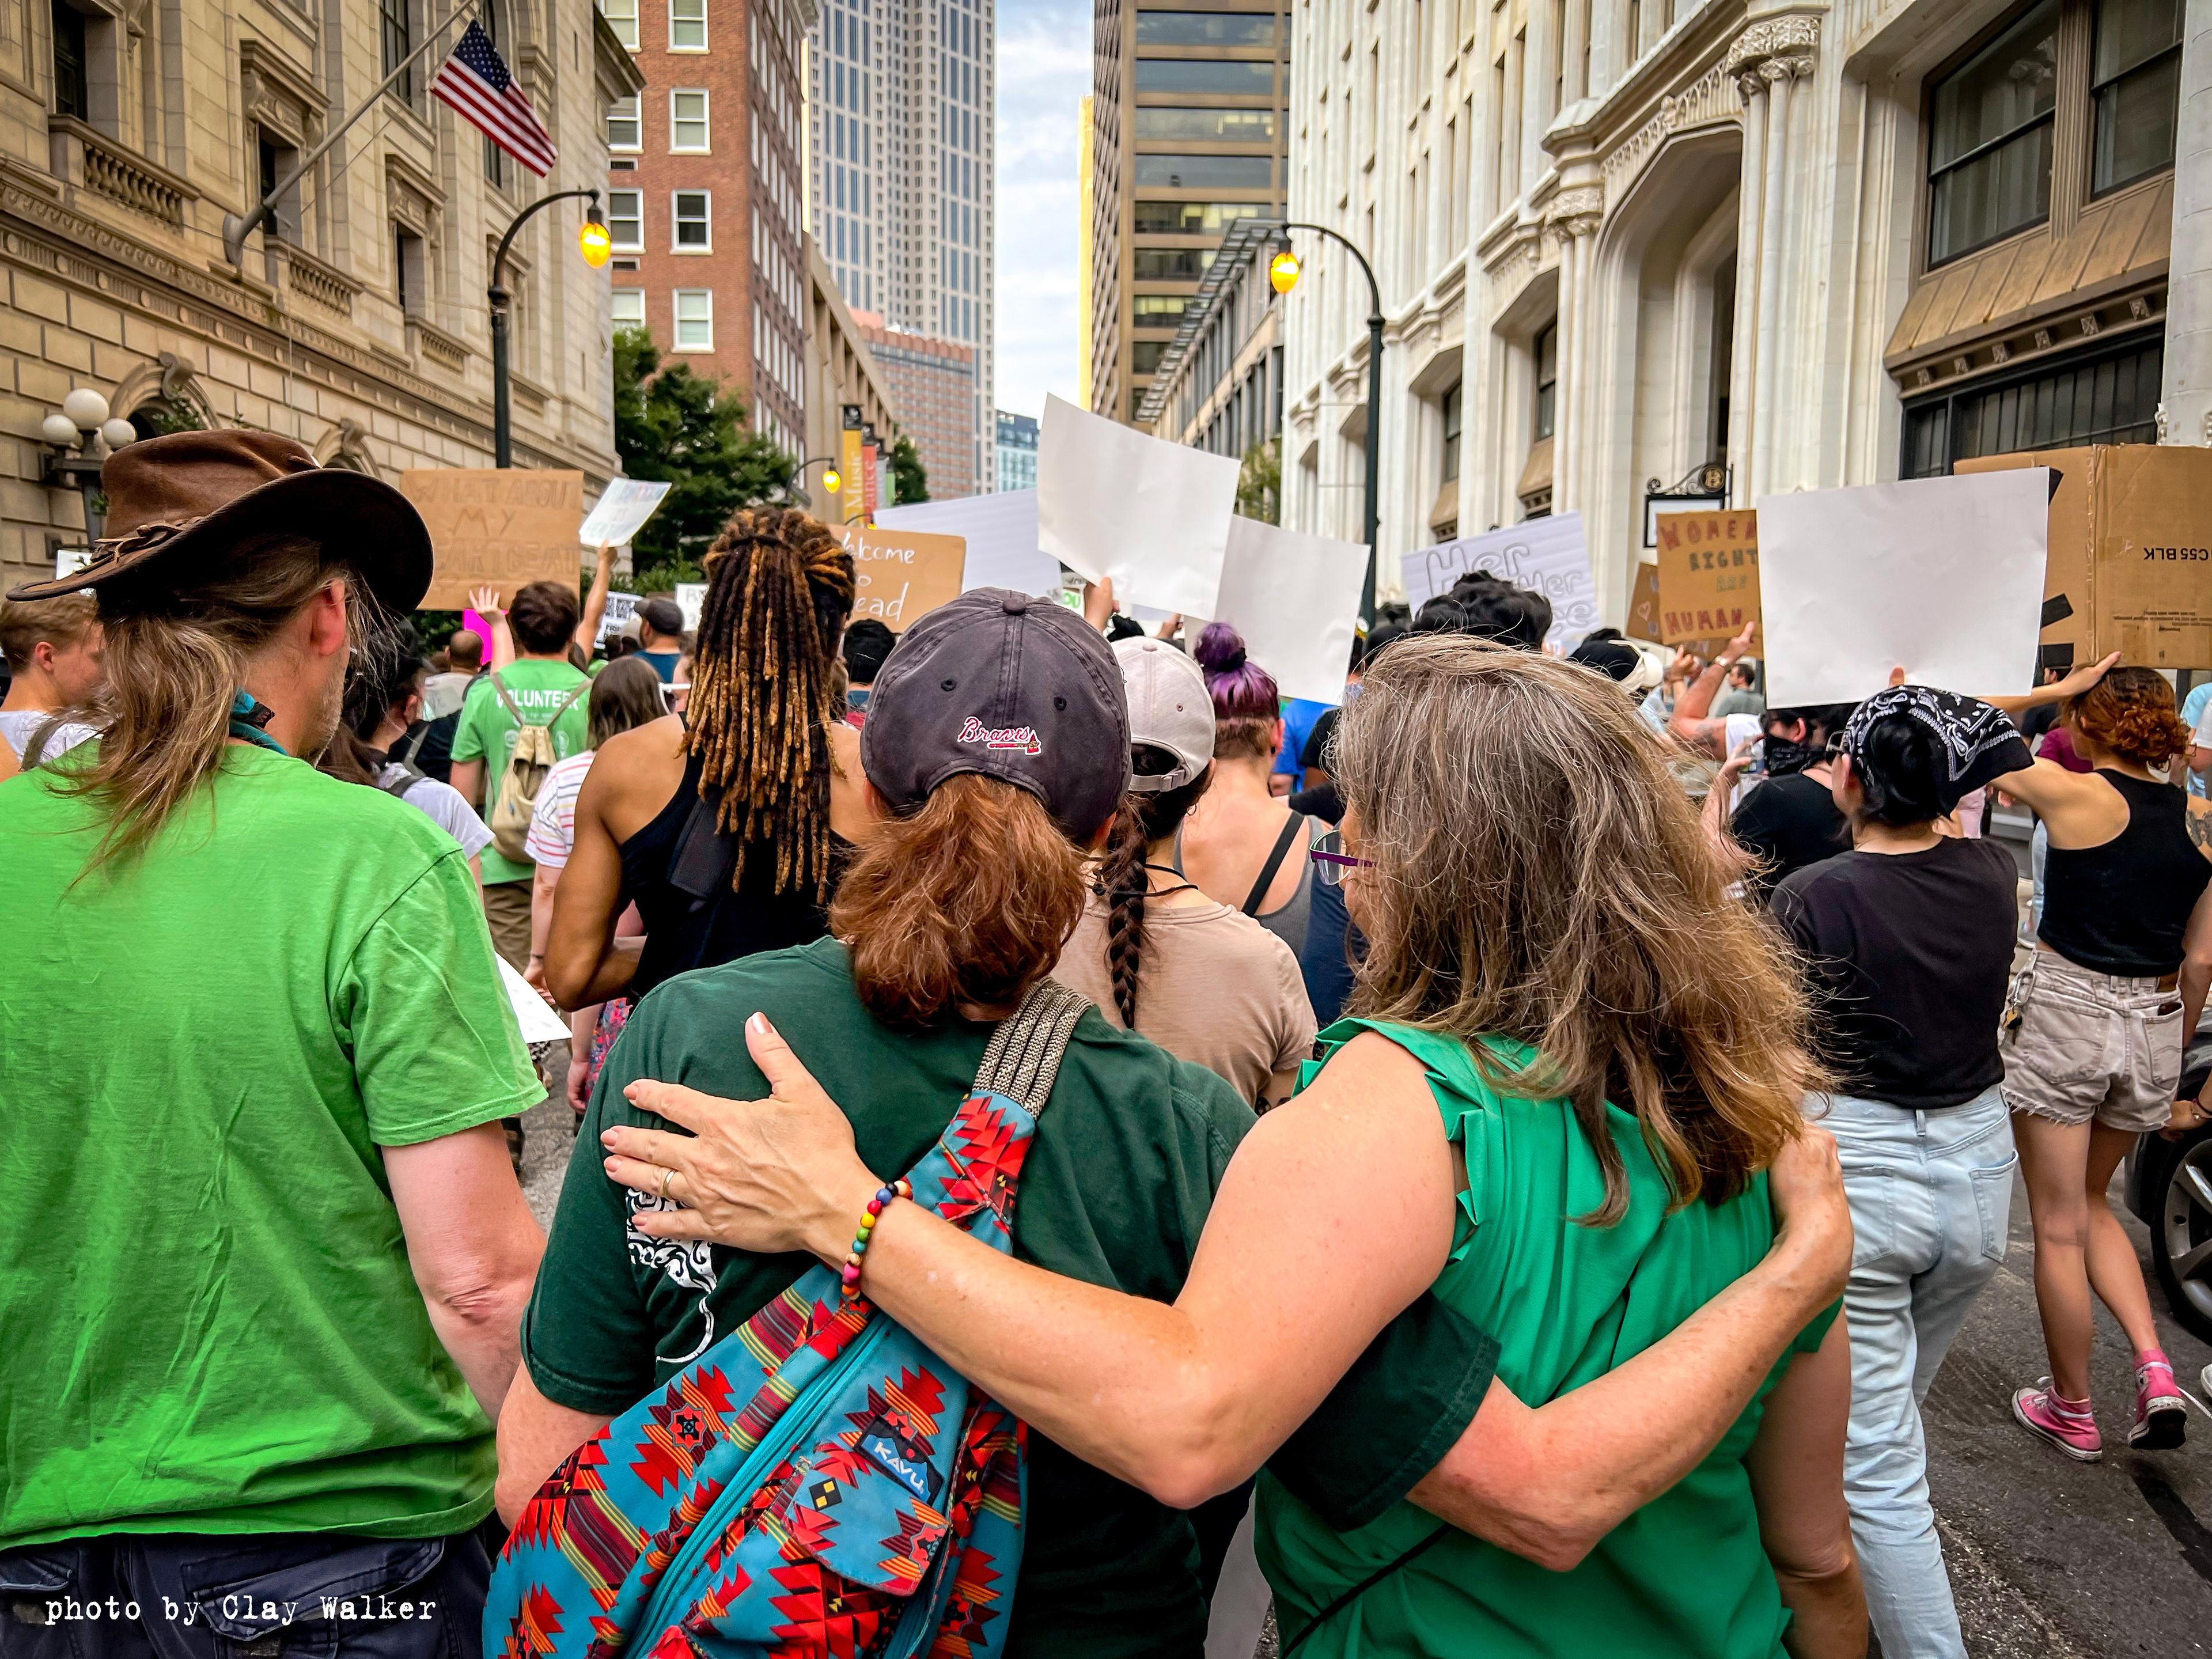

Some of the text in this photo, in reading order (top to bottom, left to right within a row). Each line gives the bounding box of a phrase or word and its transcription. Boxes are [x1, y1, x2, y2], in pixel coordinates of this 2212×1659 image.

[406, 475, 499, 503] WHAT
[844, 450, 863, 509] Music
[452, 507, 517, 537] MY
[841, 531, 916, 565] elcome
[2143, 547, 2212, 562] C55 BLK
[1426, 542, 1530, 596] Her
[1716, 574, 1747, 593] ARE
[1665, 607, 1743, 637] HUMAN
[957, 715, 1030, 743] Braves
[873, 1441, 924, 1490] KAVU
